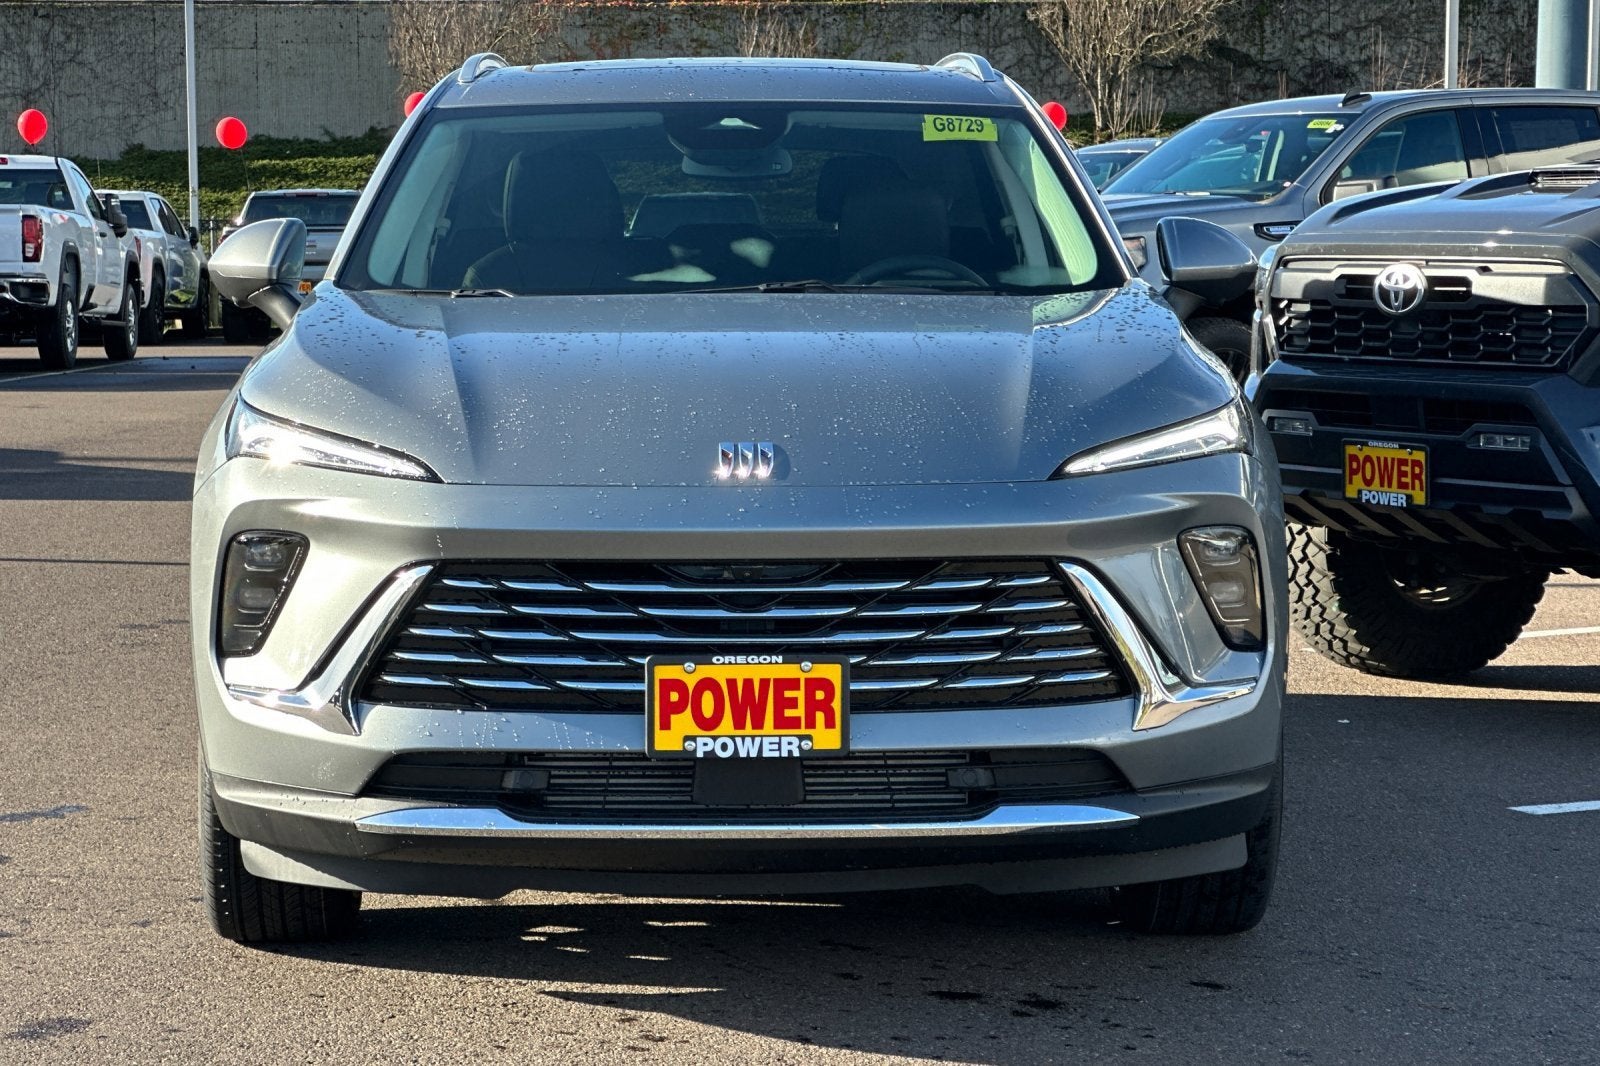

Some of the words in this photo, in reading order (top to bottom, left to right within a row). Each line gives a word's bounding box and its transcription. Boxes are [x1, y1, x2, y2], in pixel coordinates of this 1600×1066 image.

[933, 117, 984, 133] G8729
[1368, 441, 1400, 449] OREGON
[1348, 453, 1424, 492] POWER
[1361, 490, 1407, 507] POWER
[712, 655, 783, 664] OREGON
[659, 676, 836, 731] POWER
[696, 736, 800, 758] POWER
